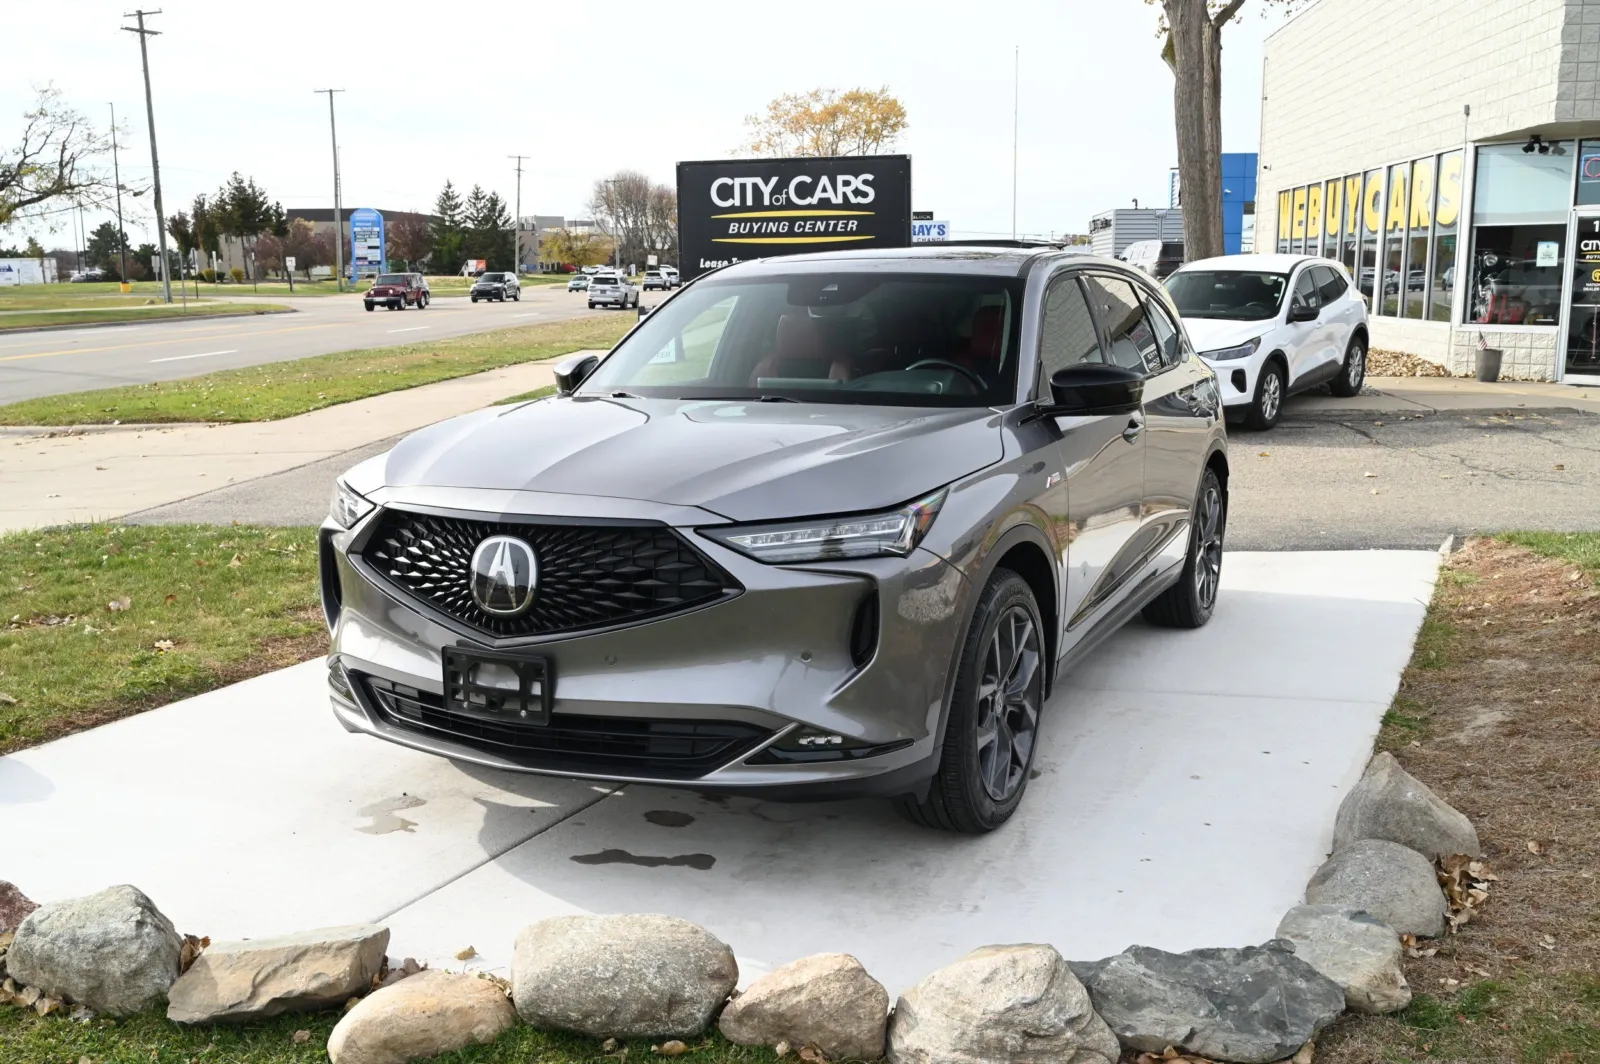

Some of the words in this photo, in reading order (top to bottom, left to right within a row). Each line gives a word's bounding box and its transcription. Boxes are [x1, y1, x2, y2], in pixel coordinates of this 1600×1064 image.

[710, 177, 779, 207] CITY
[772, 189, 787, 205] of
[788, 173, 875, 205] CARS
[729, 221, 789, 234] BUYING
[794, 220, 858, 232] CENTER
[700, 258, 729, 268] Lease
